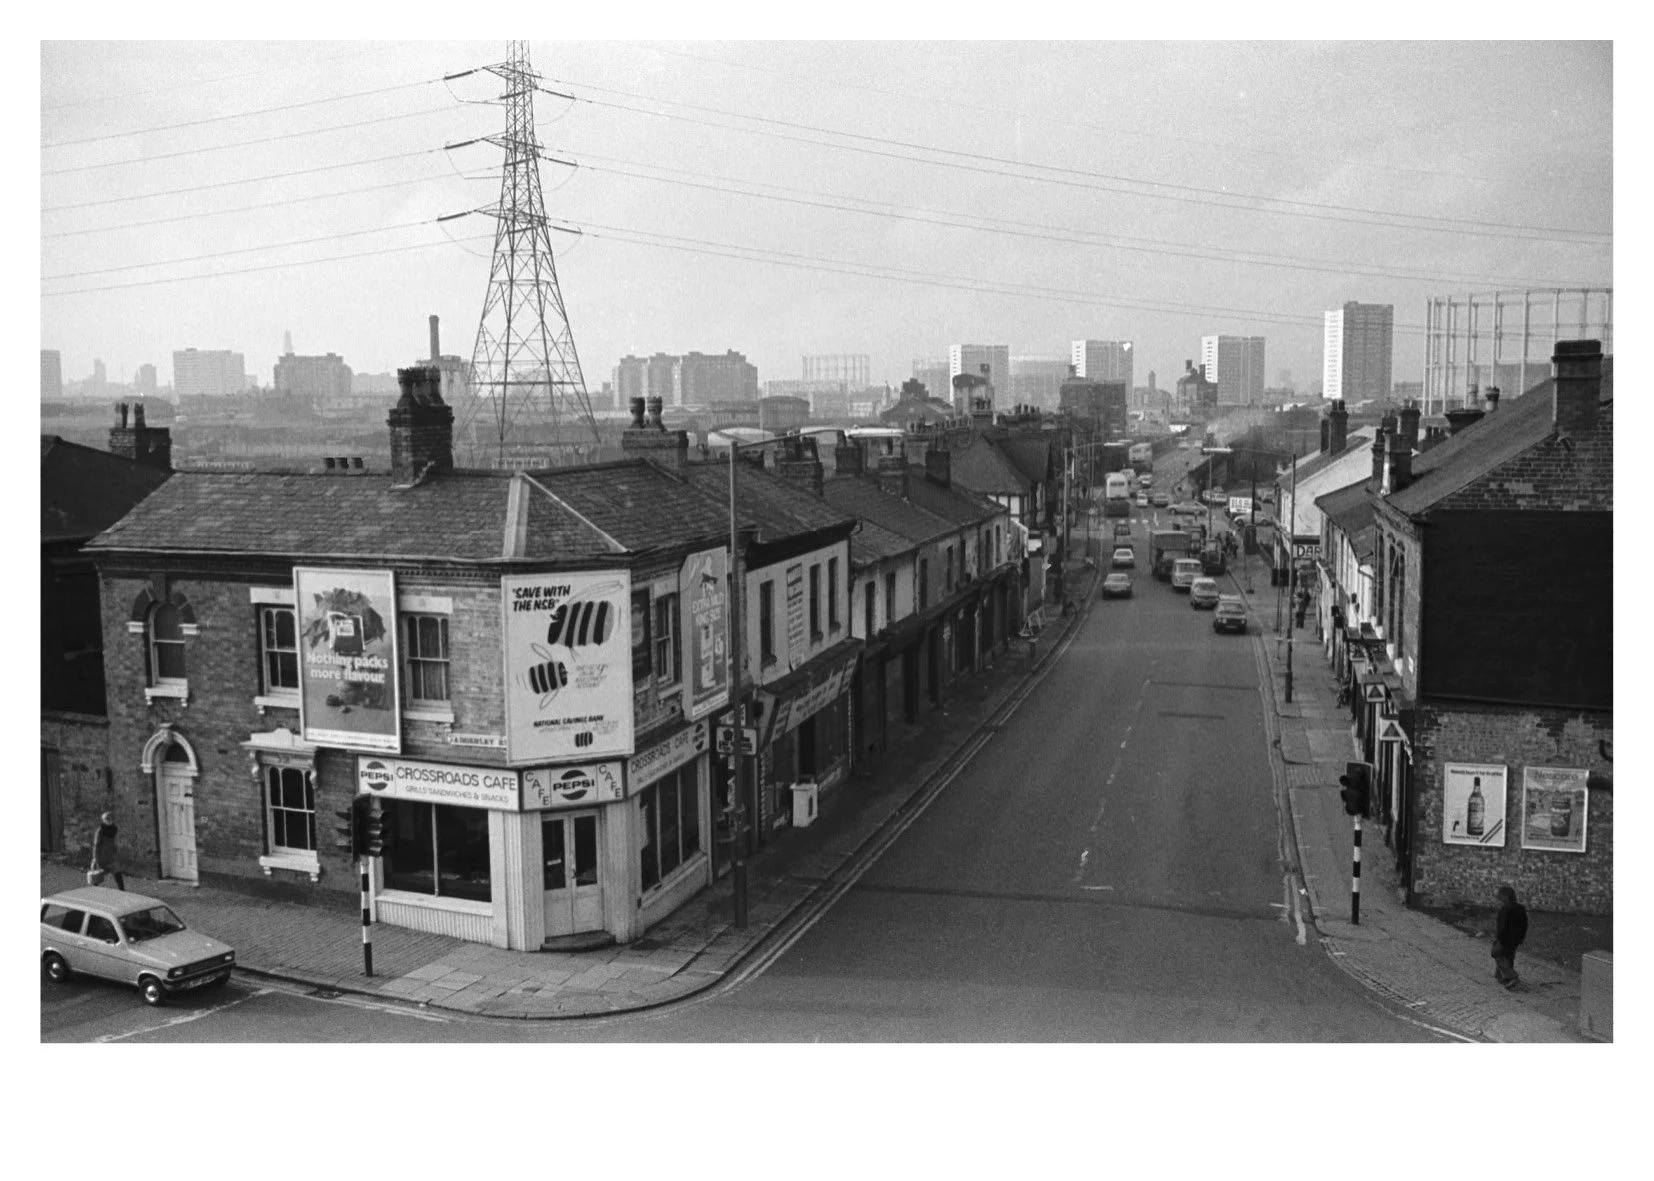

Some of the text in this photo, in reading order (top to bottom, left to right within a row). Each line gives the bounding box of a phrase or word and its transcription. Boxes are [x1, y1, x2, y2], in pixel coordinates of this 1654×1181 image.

[512, 584, 571, 599] "SAVE WITH
[513, 599, 560, 612] THE NSB"
[306, 652, 388, 671] Nothing packs
[310, 668, 340, 680] more
[533, 718, 561, 728] NATIONAL
[631, 741, 671, 774] CROSSROADS
[675, 731, 689, 749] CAFE
[360, 770, 393, 782] PEPSI
[396, 766, 516, 791] CROSSROADS CAFE
[599, 764, 622, 798] CAFE
[525, 772, 549, 806] CAFE
[553, 779, 595, 792] PEPSI
[405, 785, 427, 795] GRILLS
[428, 787, 473, 800] SANDWICHES
[482, 793, 509, 803] SNACKS
